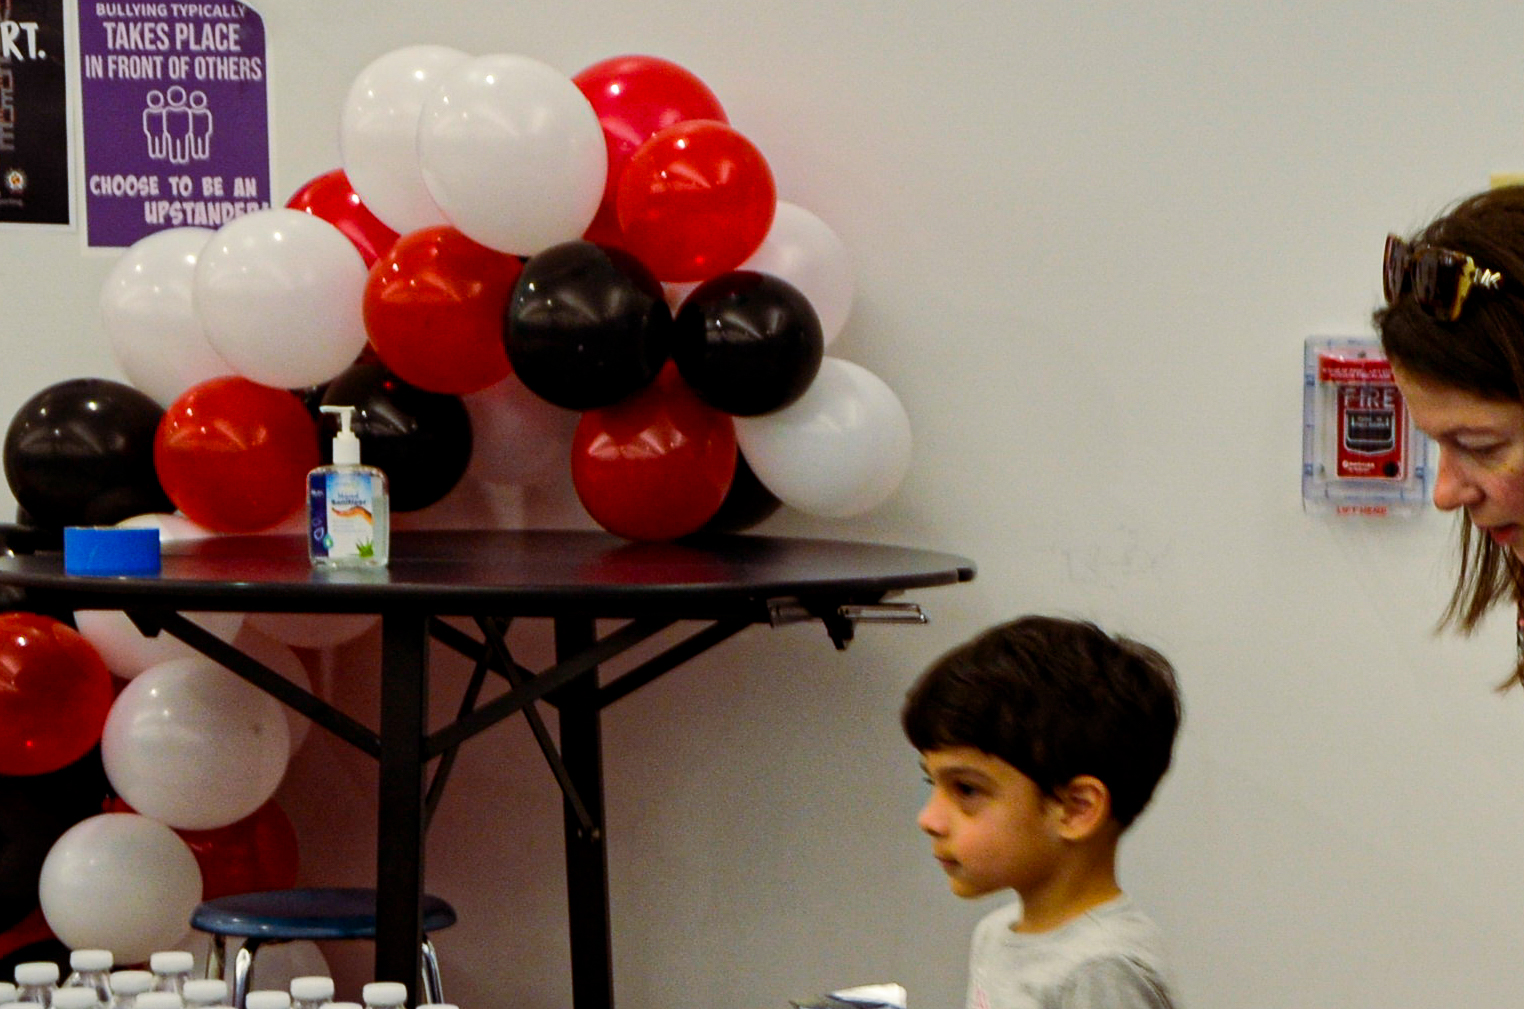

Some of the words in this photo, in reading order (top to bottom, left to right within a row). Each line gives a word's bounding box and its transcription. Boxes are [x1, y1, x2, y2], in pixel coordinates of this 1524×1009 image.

[96, 2, 168, 17] BULLYING
[170, 3, 247, 18] TYPICALLY
[103, 21, 170, 51] TAKES
[175, 22, 241, 51] PLACE
[85, 54, 104, 79] IN
[107, 55, 163, 80] FRONT
[168, 56, 190, 80] OF
[194, 56, 262, 81] OTHERS
[89, 174, 160, 197] CHOOSE
[168, 174, 193, 197] TO
[201, 176, 224, 197] BE
[233, 177, 257, 198] AN
